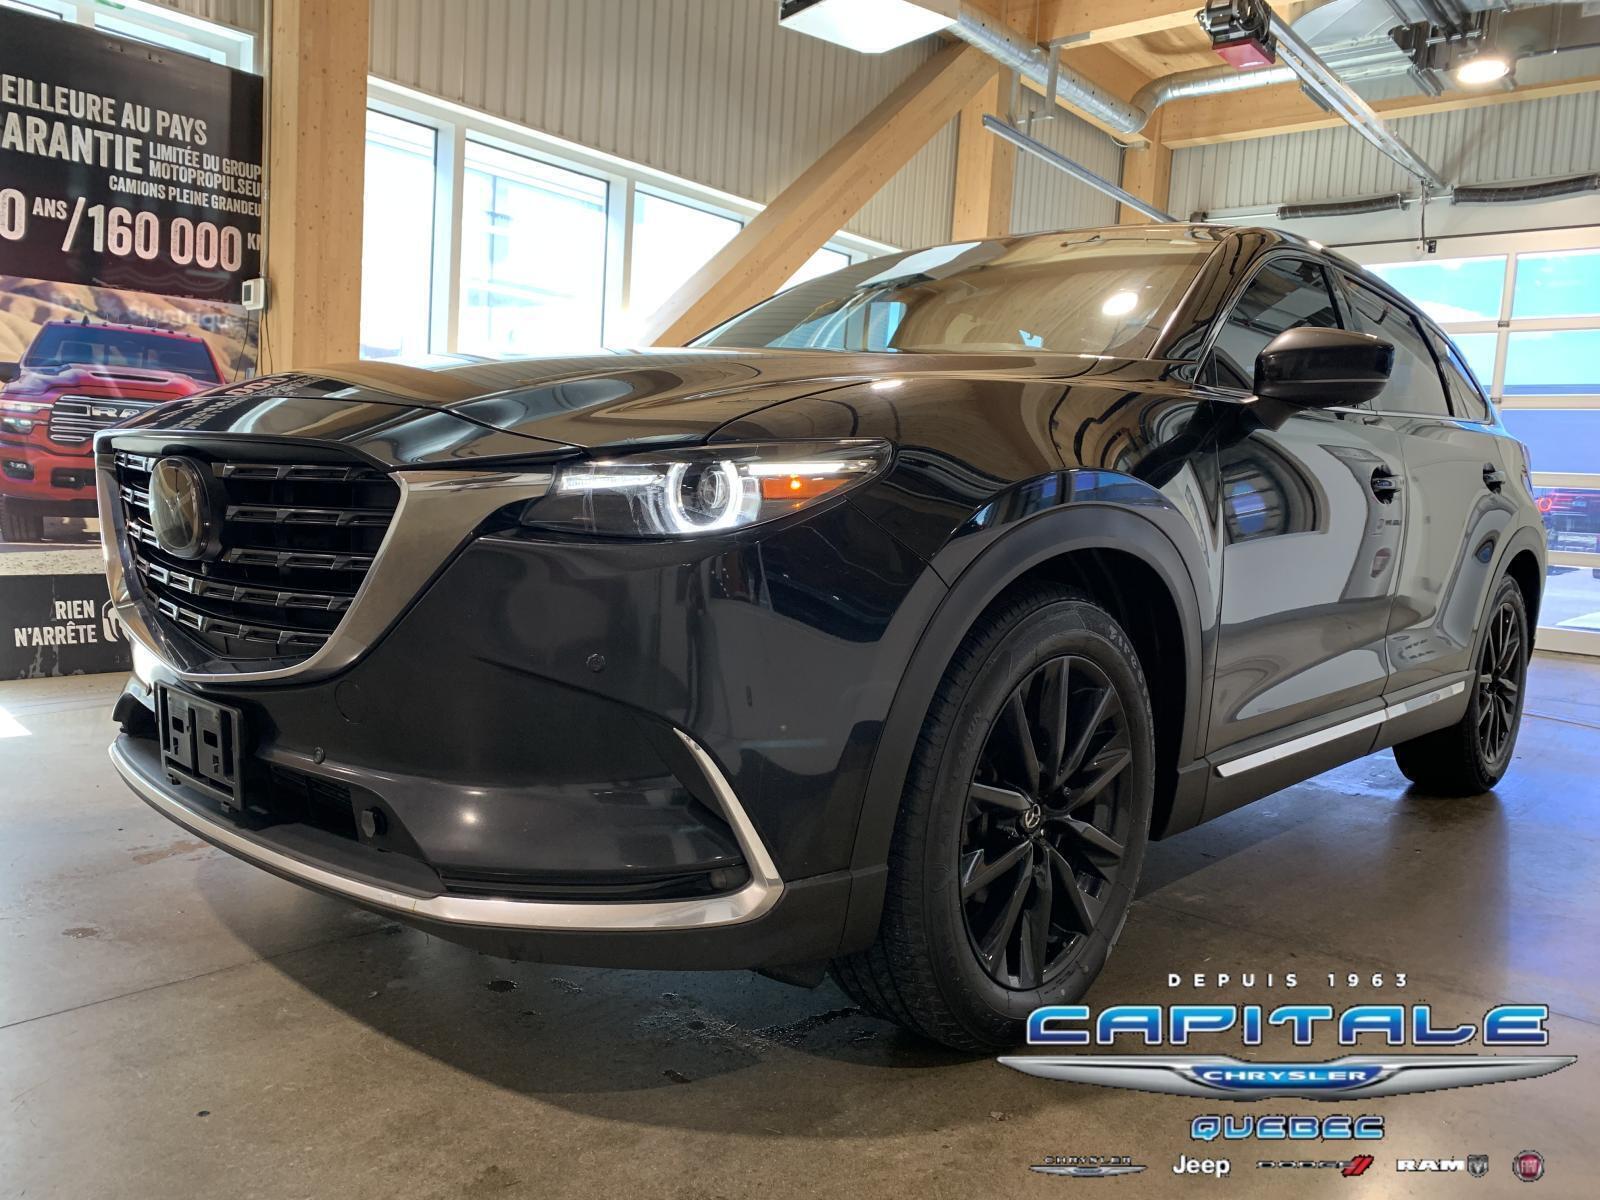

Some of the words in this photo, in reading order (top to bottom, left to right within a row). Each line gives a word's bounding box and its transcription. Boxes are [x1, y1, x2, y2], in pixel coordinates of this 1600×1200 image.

[120, 102, 150, 133] AU
[156, 110, 208, 145] PAYS
[0, 111, 143, 175] ARANTIE
[149, 141, 201, 168] LIMITÉE
[203, 153, 220, 172] DU
[109, 175, 166, 200] CAMIONS
[168, 186, 209, 207] PLEINE
[32, 196, 68, 220] ANS
[170, 217, 242, 272] 000
[55, 600, 95, 620] RIEN
